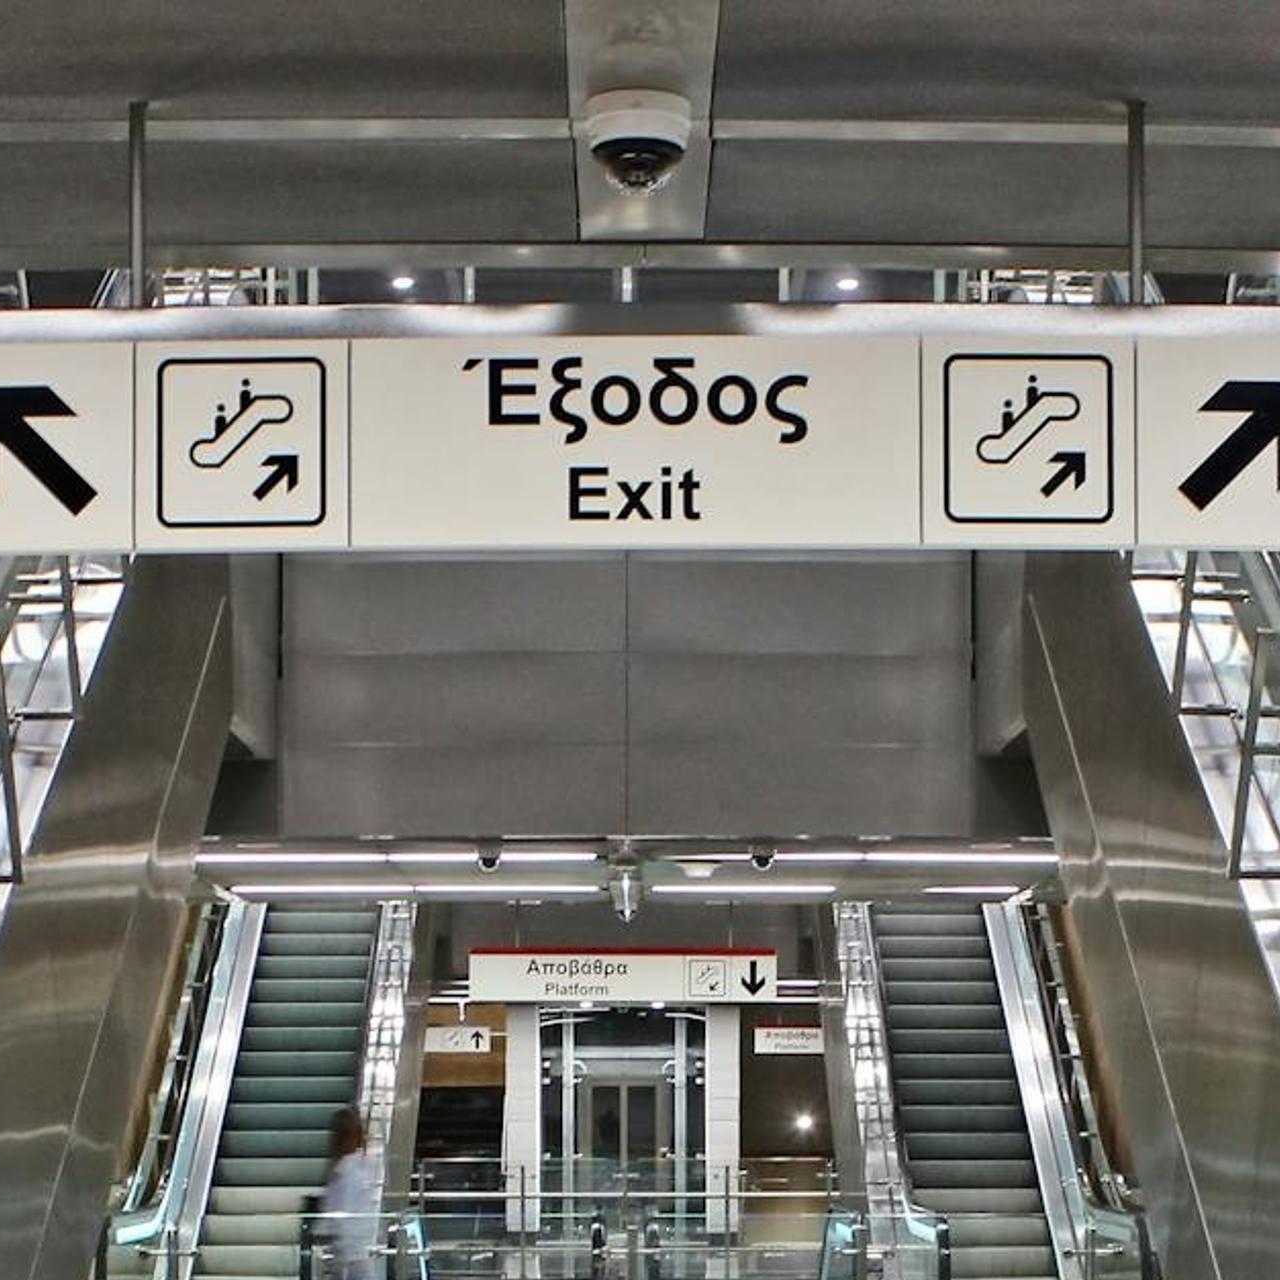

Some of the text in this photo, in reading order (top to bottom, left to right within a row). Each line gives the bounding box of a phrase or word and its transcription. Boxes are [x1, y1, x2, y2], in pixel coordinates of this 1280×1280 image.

[462, 357, 809, 444] Έξοδος
[568, 466, 701, 520] Exit
[526, 959, 628, 979] Αποβάθρα
[545, 983, 610, 996] Platform
